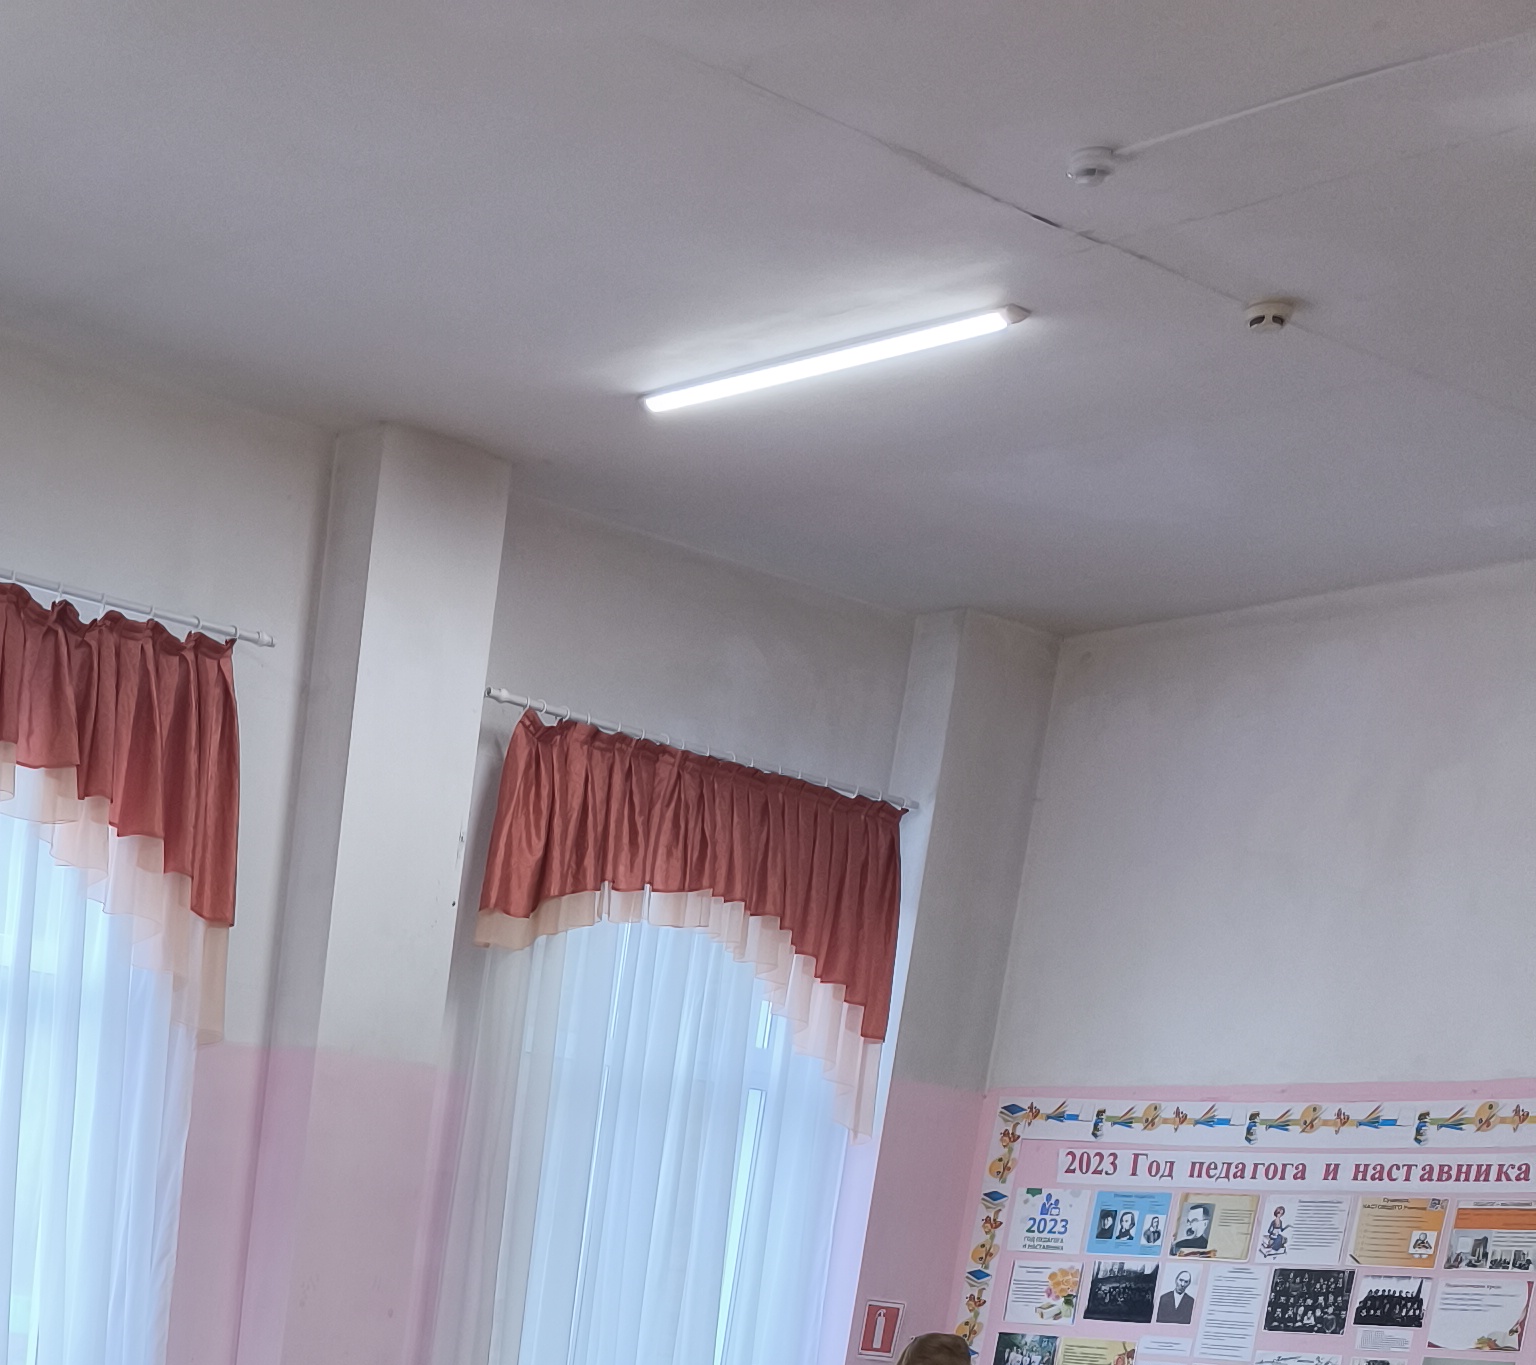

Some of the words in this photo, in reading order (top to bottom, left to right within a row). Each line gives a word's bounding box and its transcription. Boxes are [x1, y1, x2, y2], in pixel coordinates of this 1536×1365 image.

[1064, 1151, 1118, 1176] 2023
[1129, 1153, 1176, 1180] Год
[1188, 1161, 1307, 1182] педагога
[1322, 1162, 1341, 1181] и
[1351, 1162, 1532, 1183] наставника
[1025, 1217, 1069, 1235] 2023
